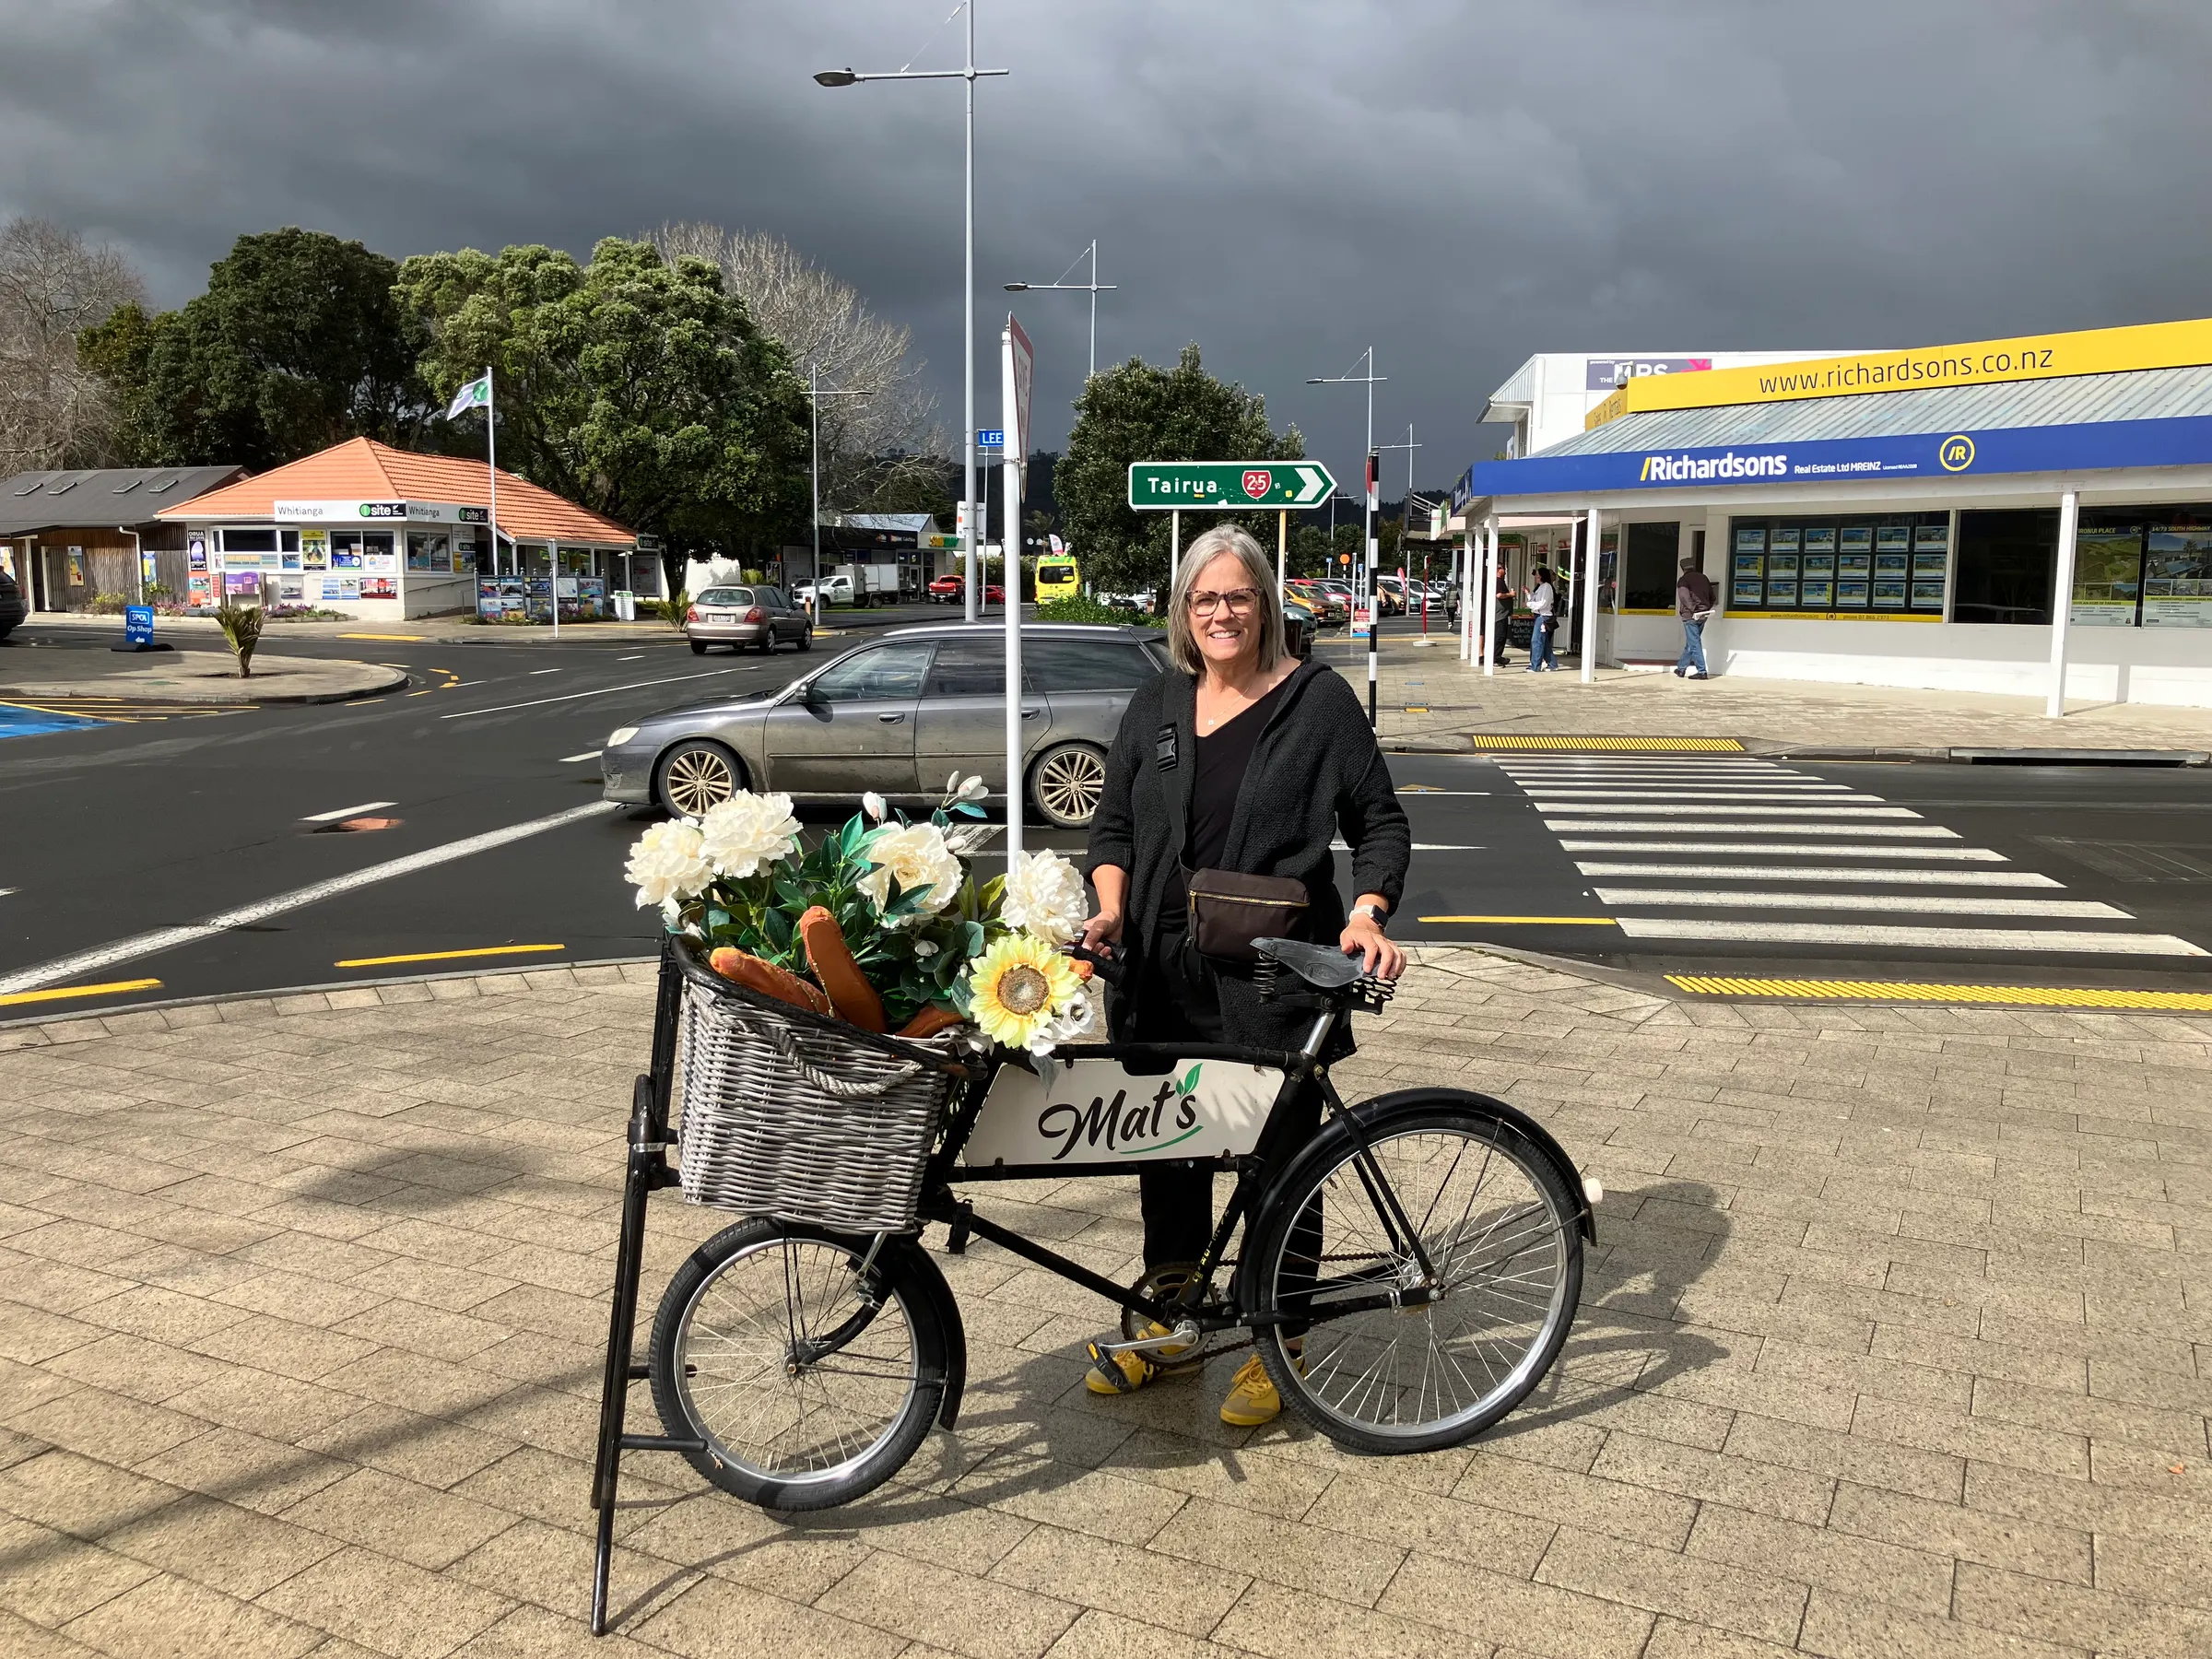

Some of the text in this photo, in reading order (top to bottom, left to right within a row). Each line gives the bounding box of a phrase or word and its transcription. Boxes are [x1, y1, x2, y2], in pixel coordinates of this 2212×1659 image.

[1759, 349, 2053, 394] www.richardsons.co.nz
[982, 432, 1003, 444] LEE
[1794, 465, 1811, 475] Real
[1811, 464, 1836, 474] Estate
[1837, 462, 1850, 472] Ltd
[1850, 461, 1881, 472] MREINZ
[1147, 475, 1266, 494] Tairua 25
[277, 506, 323, 516] Whitianga
[409, 506, 440, 518] Whitianga
[132, 613, 147, 622] SPCA
[127, 625, 152, 634] Op Shop
[1038, 1080, 1196, 1159] Mat's
